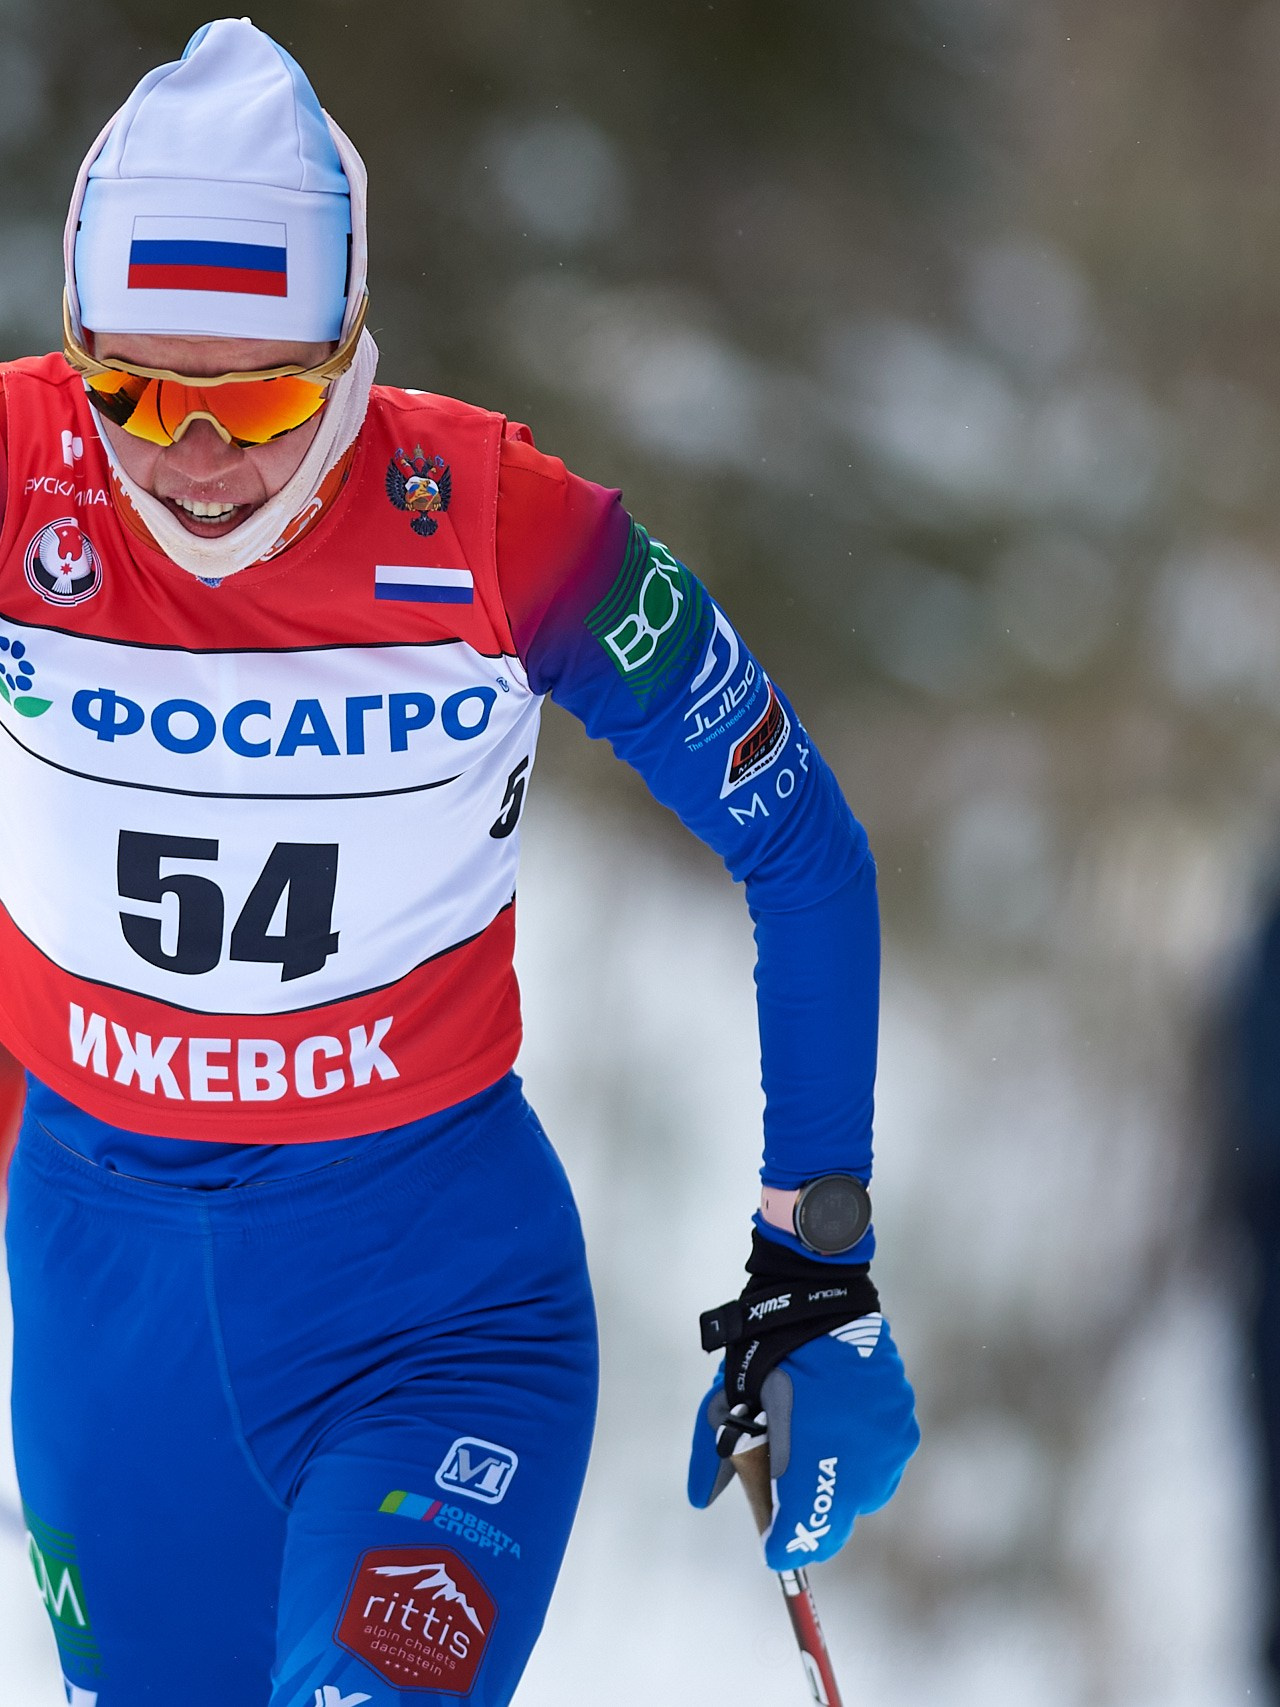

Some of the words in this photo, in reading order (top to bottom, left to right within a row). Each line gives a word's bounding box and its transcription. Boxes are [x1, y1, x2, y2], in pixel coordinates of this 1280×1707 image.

[71, 685, 500, 758] ФОСАГРО
[684, 660, 755, 743] Julbo
[687, 740, 704, 753] The
[703, 726, 726, 744] world
[725, 708, 746, 729] needs
[117, 829, 341, 982] 54
[69, 1002, 400, 1101] ИЖЕВСК
[433, 1516, 506, 1558] СПОРТ
[439, 1503, 520, 1559] ЮВЕНТА
[363, 1592, 470, 1659] rittis
[363, 1624, 401, 1642] alpin
[405, 1636, 456, 1670] chalets
[370, 1639, 443, 1677] dachstein
